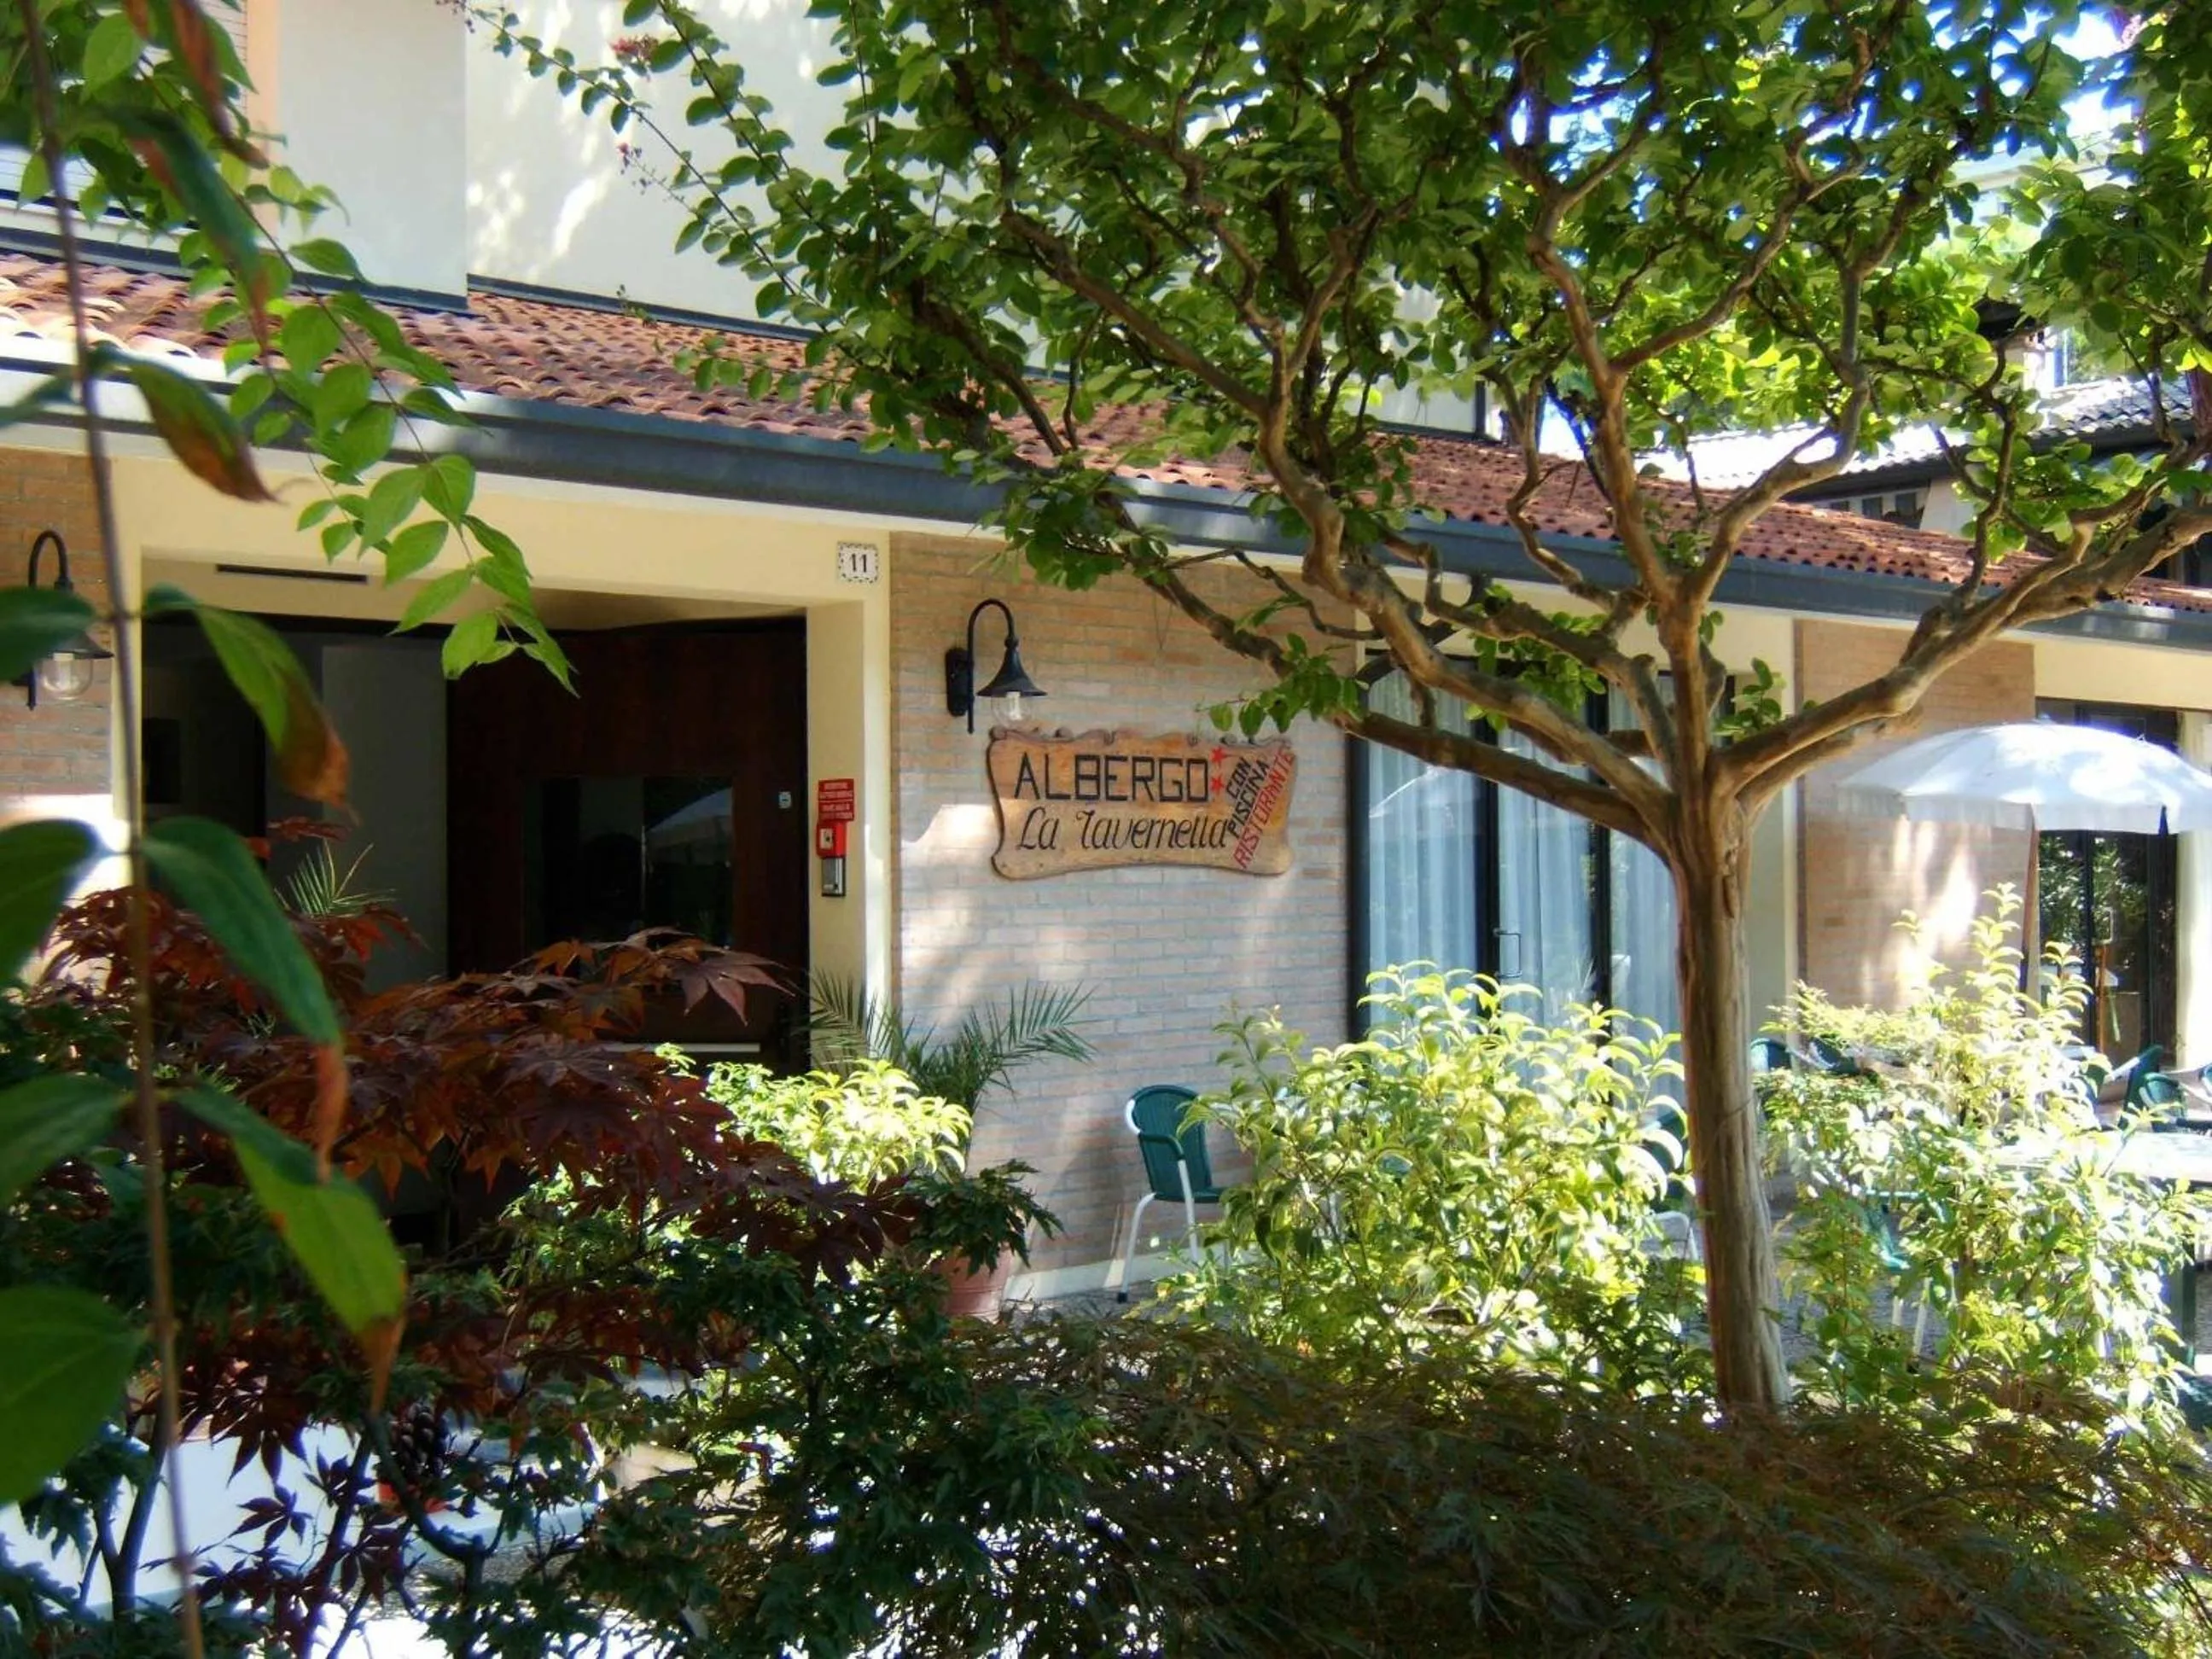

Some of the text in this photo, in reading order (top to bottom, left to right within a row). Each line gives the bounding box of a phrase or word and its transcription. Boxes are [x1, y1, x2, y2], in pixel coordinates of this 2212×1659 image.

[850, 553, 866, 573] 11
[1014, 752, 1209, 803] ALBERGO
[1226, 756, 1252, 800] CON
[1227, 759, 1270, 838] PISCINA
[1016, 806, 1230, 851] La Tavernella
[1233, 748, 1296, 870] RISTORANTE
